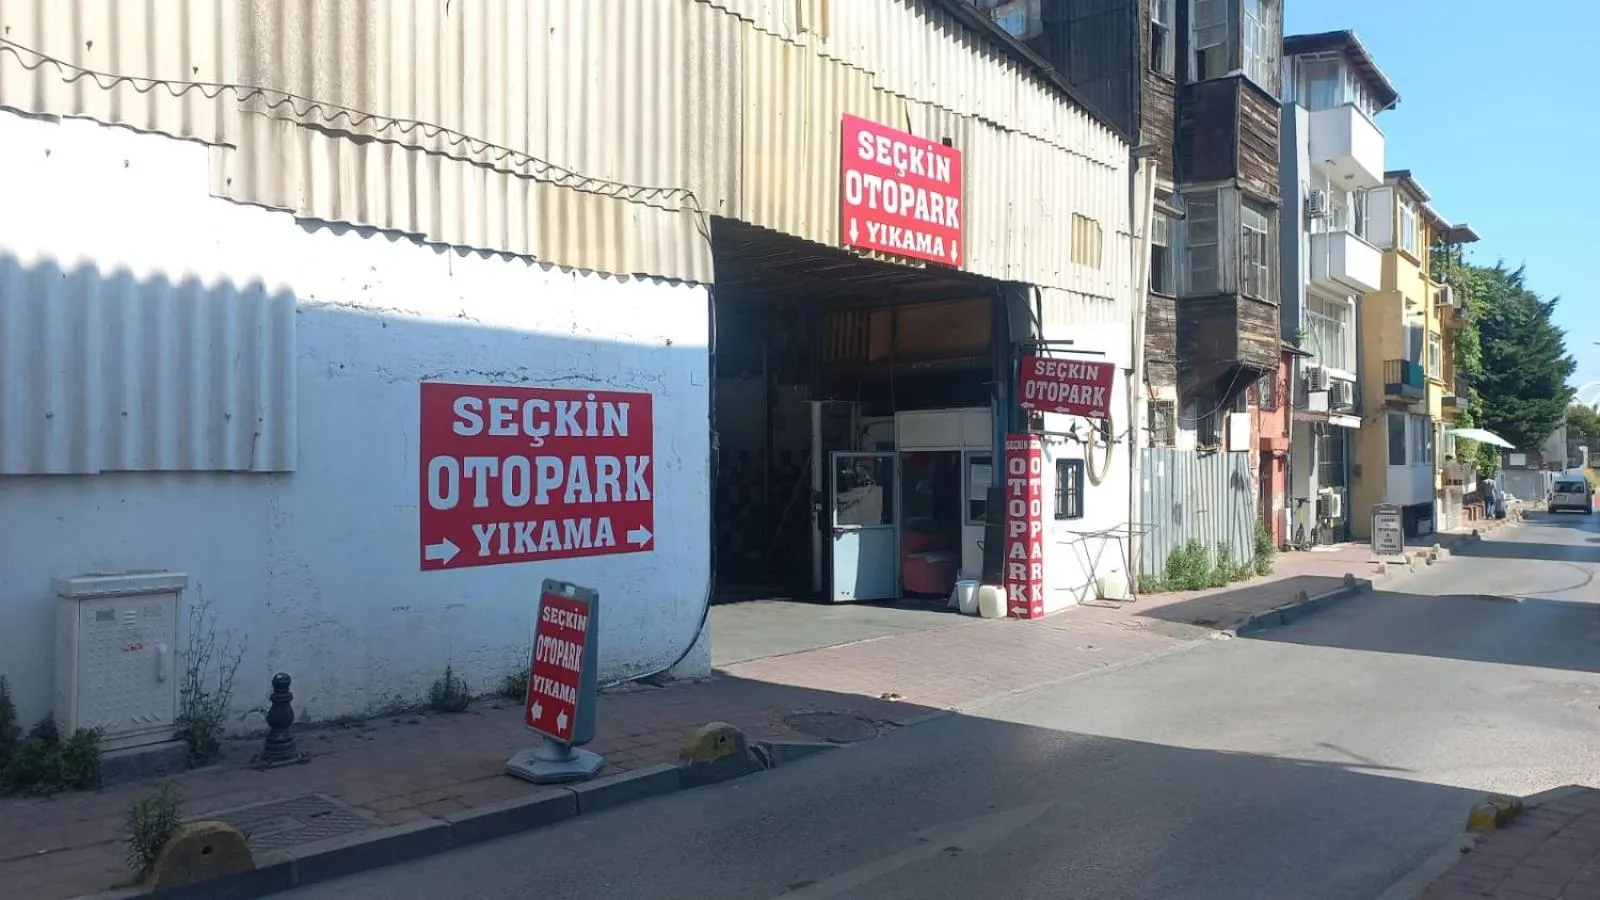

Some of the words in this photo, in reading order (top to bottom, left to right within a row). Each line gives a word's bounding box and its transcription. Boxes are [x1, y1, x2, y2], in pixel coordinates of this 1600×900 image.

[858, 130, 951, 184] SEÇKİN
[845, 169, 960, 229] OTOPARK
[866, 221, 945, 257] YIKAMA
[1025, 380, 1105, 407] OTOPARK
[453, 392, 630, 447] SEÇKİN
[428, 455, 651, 510] OTOPARK
[472, 517, 616, 557] YIKAMA
[1007, 457, 1028, 602] OTOPARK
[542, 606, 587, 632] SEÇKİN
[536, 633, 583, 672] OTOPARK
[533, 675, 576, 705] YIKAMA
